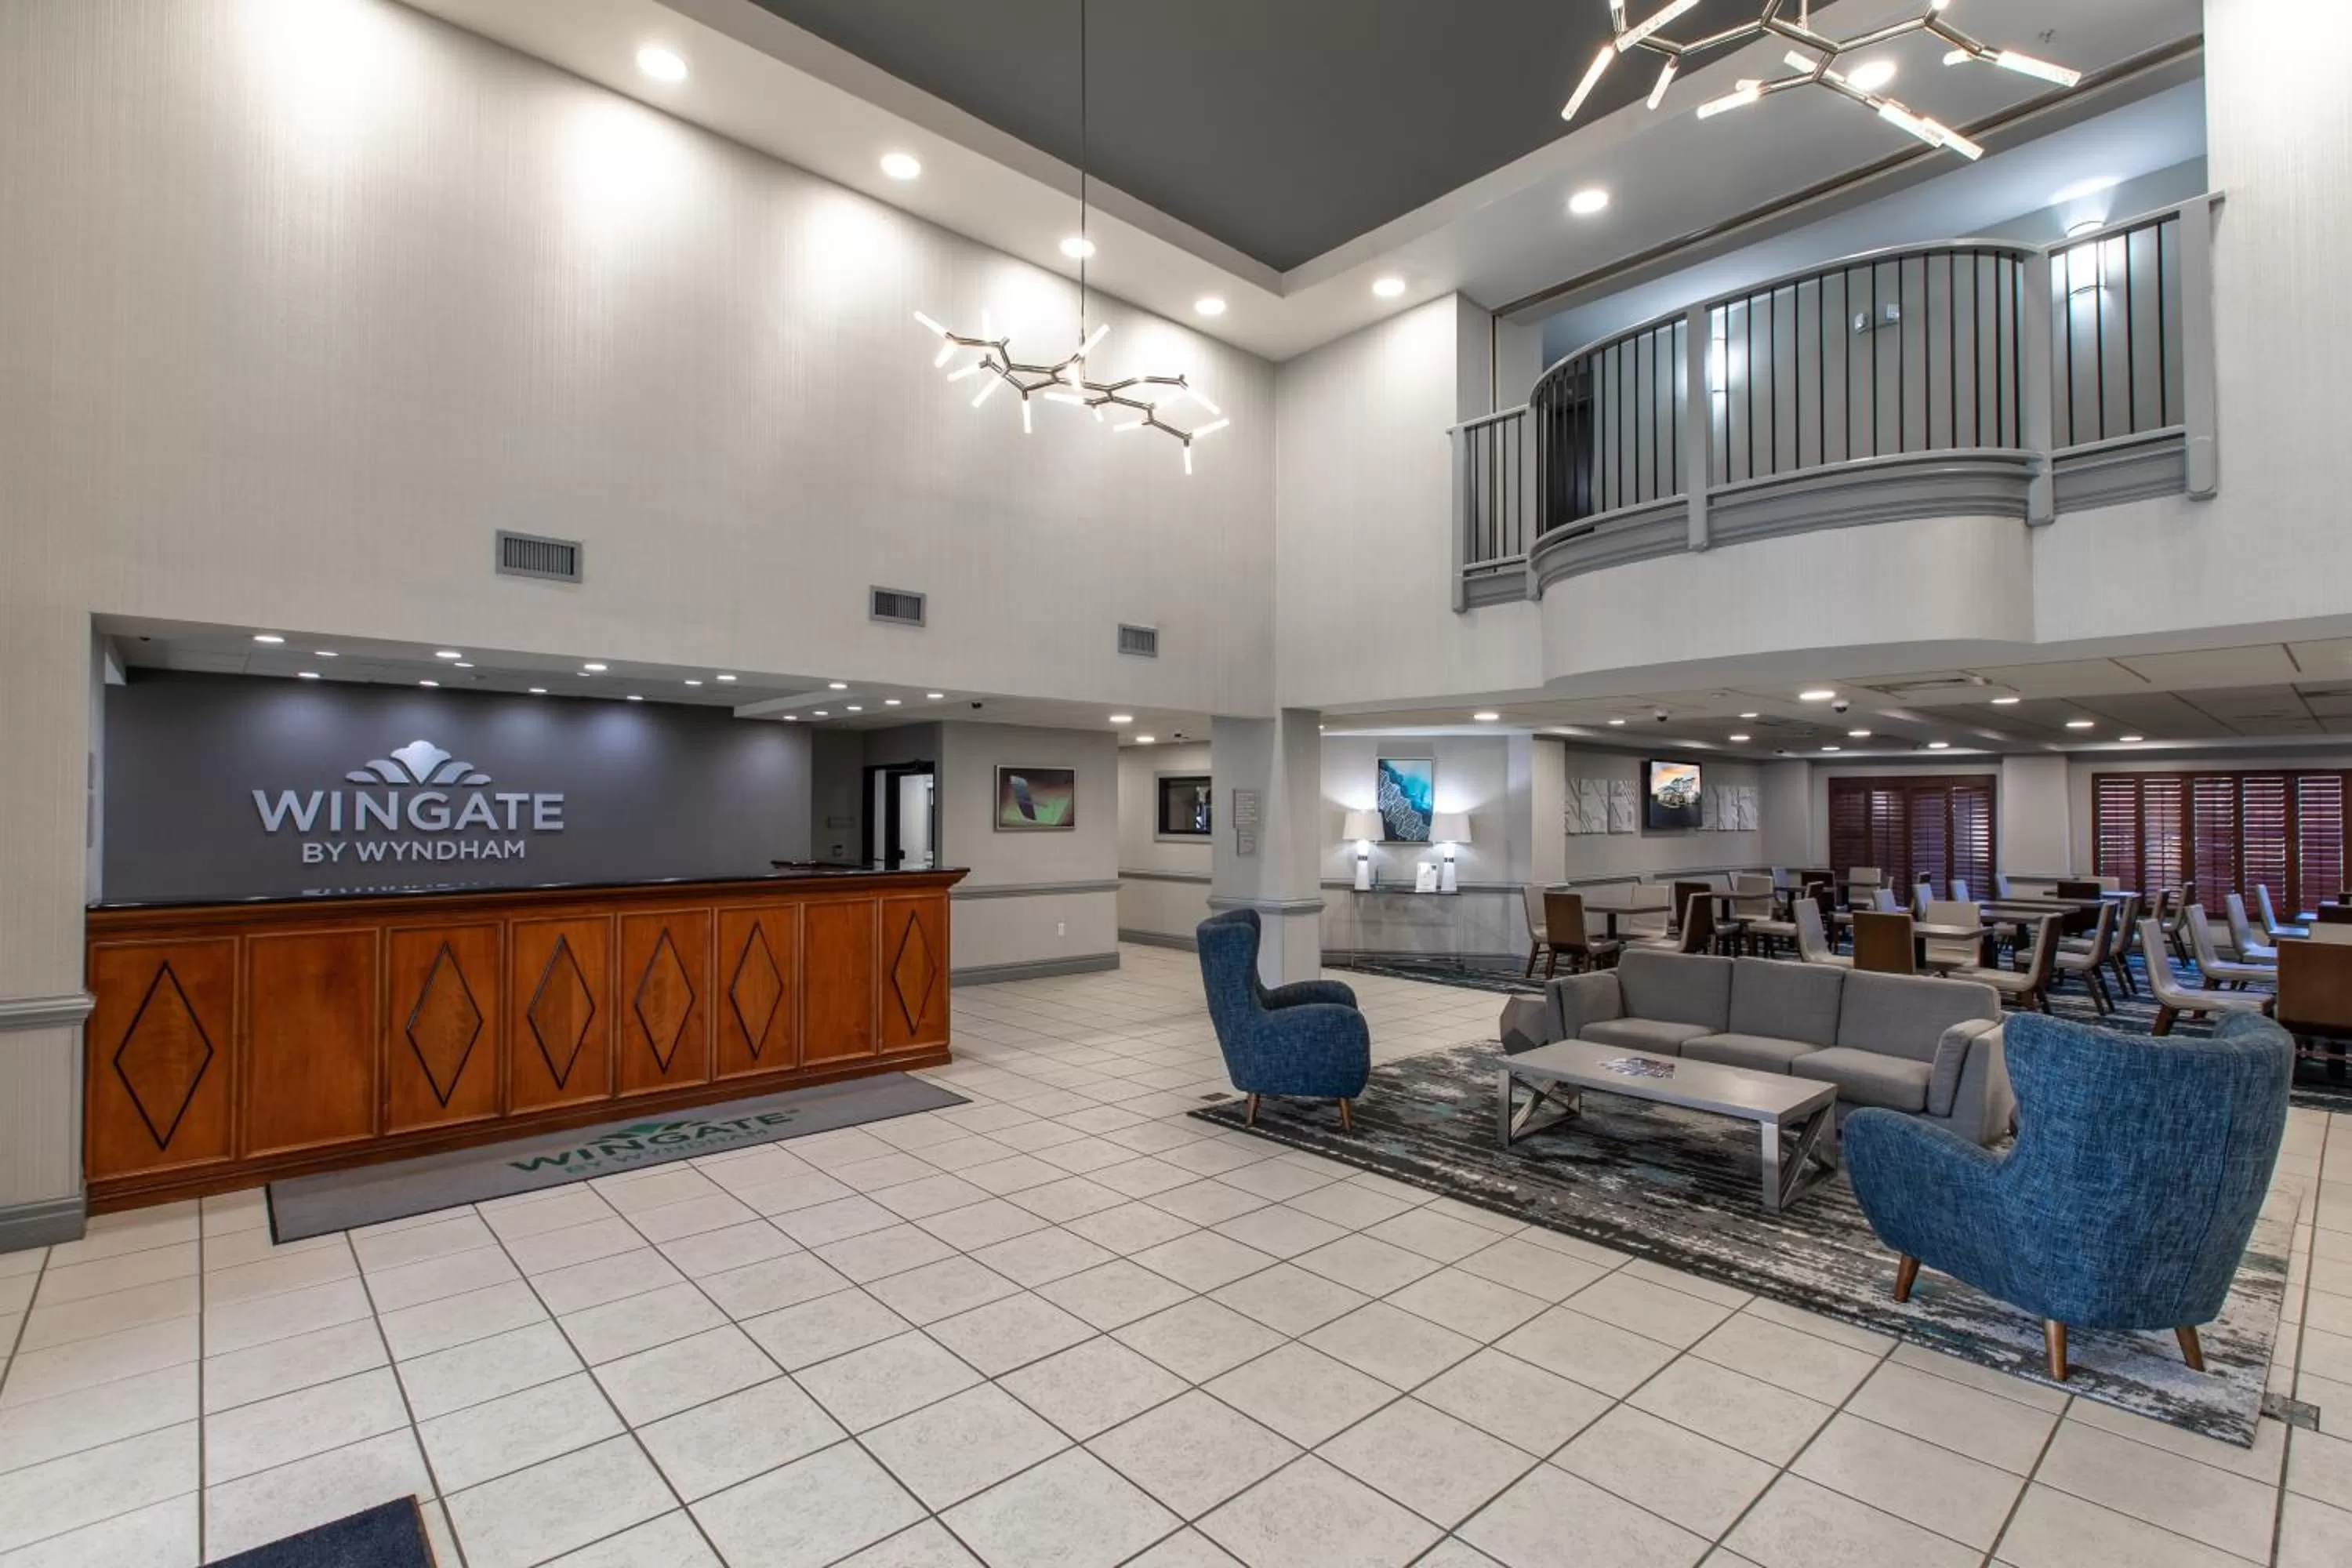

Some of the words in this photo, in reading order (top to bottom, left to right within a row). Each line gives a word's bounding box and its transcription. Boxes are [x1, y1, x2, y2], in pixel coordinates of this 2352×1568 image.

[252, 789, 564, 832] WINGATE
[302, 842, 347, 863] BY
[356, 840, 527, 862] WYNDHAM
[507, 1112, 793, 1171] WINGATE
